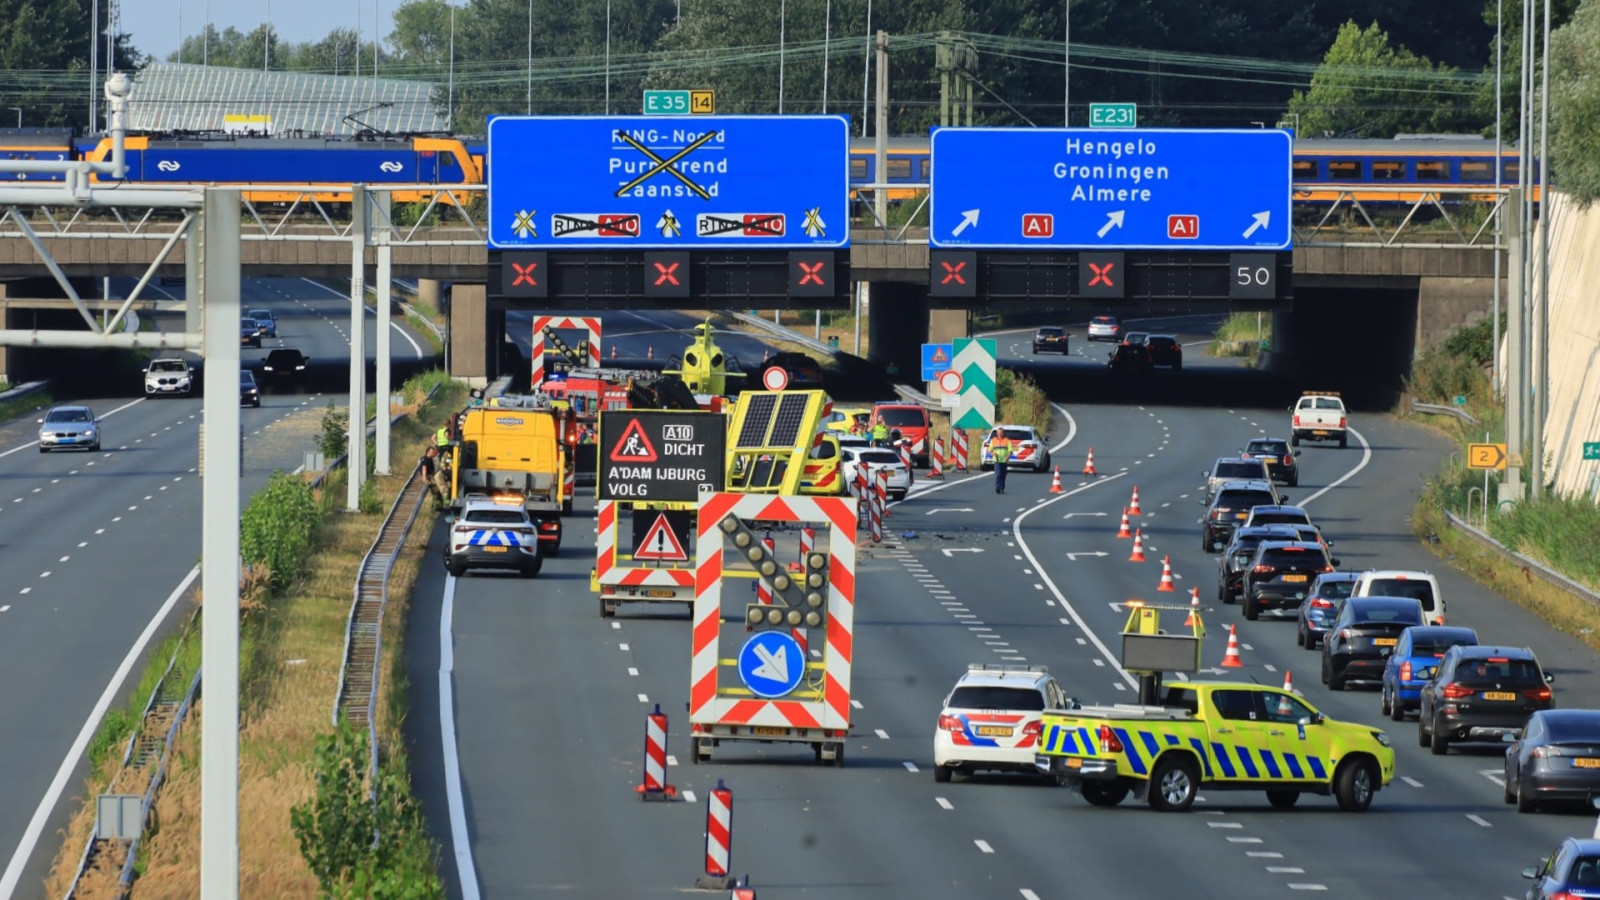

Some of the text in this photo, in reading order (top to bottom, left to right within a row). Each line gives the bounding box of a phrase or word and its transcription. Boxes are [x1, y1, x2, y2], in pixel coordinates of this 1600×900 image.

[693, 96, 711, 109] 14
[1092, 108, 1134, 123] E231
[1066, 138, 1156, 159] Hengelo
[1053, 162, 1169, 184] Groningen
[1070, 184, 1152, 202] Almere
[1027, 218, 1049, 234] A1
[1172, 219, 1195, 234] A1
[1237, 266, 1270, 285] 50
[665, 427, 691, 439] A10
[664, 443, 705, 456] DICHT
[1479, 450, 1489, 462] 2
[608, 466, 706, 481] A'DAM IJBURG
[608, 483, 648, 496] VOLG
